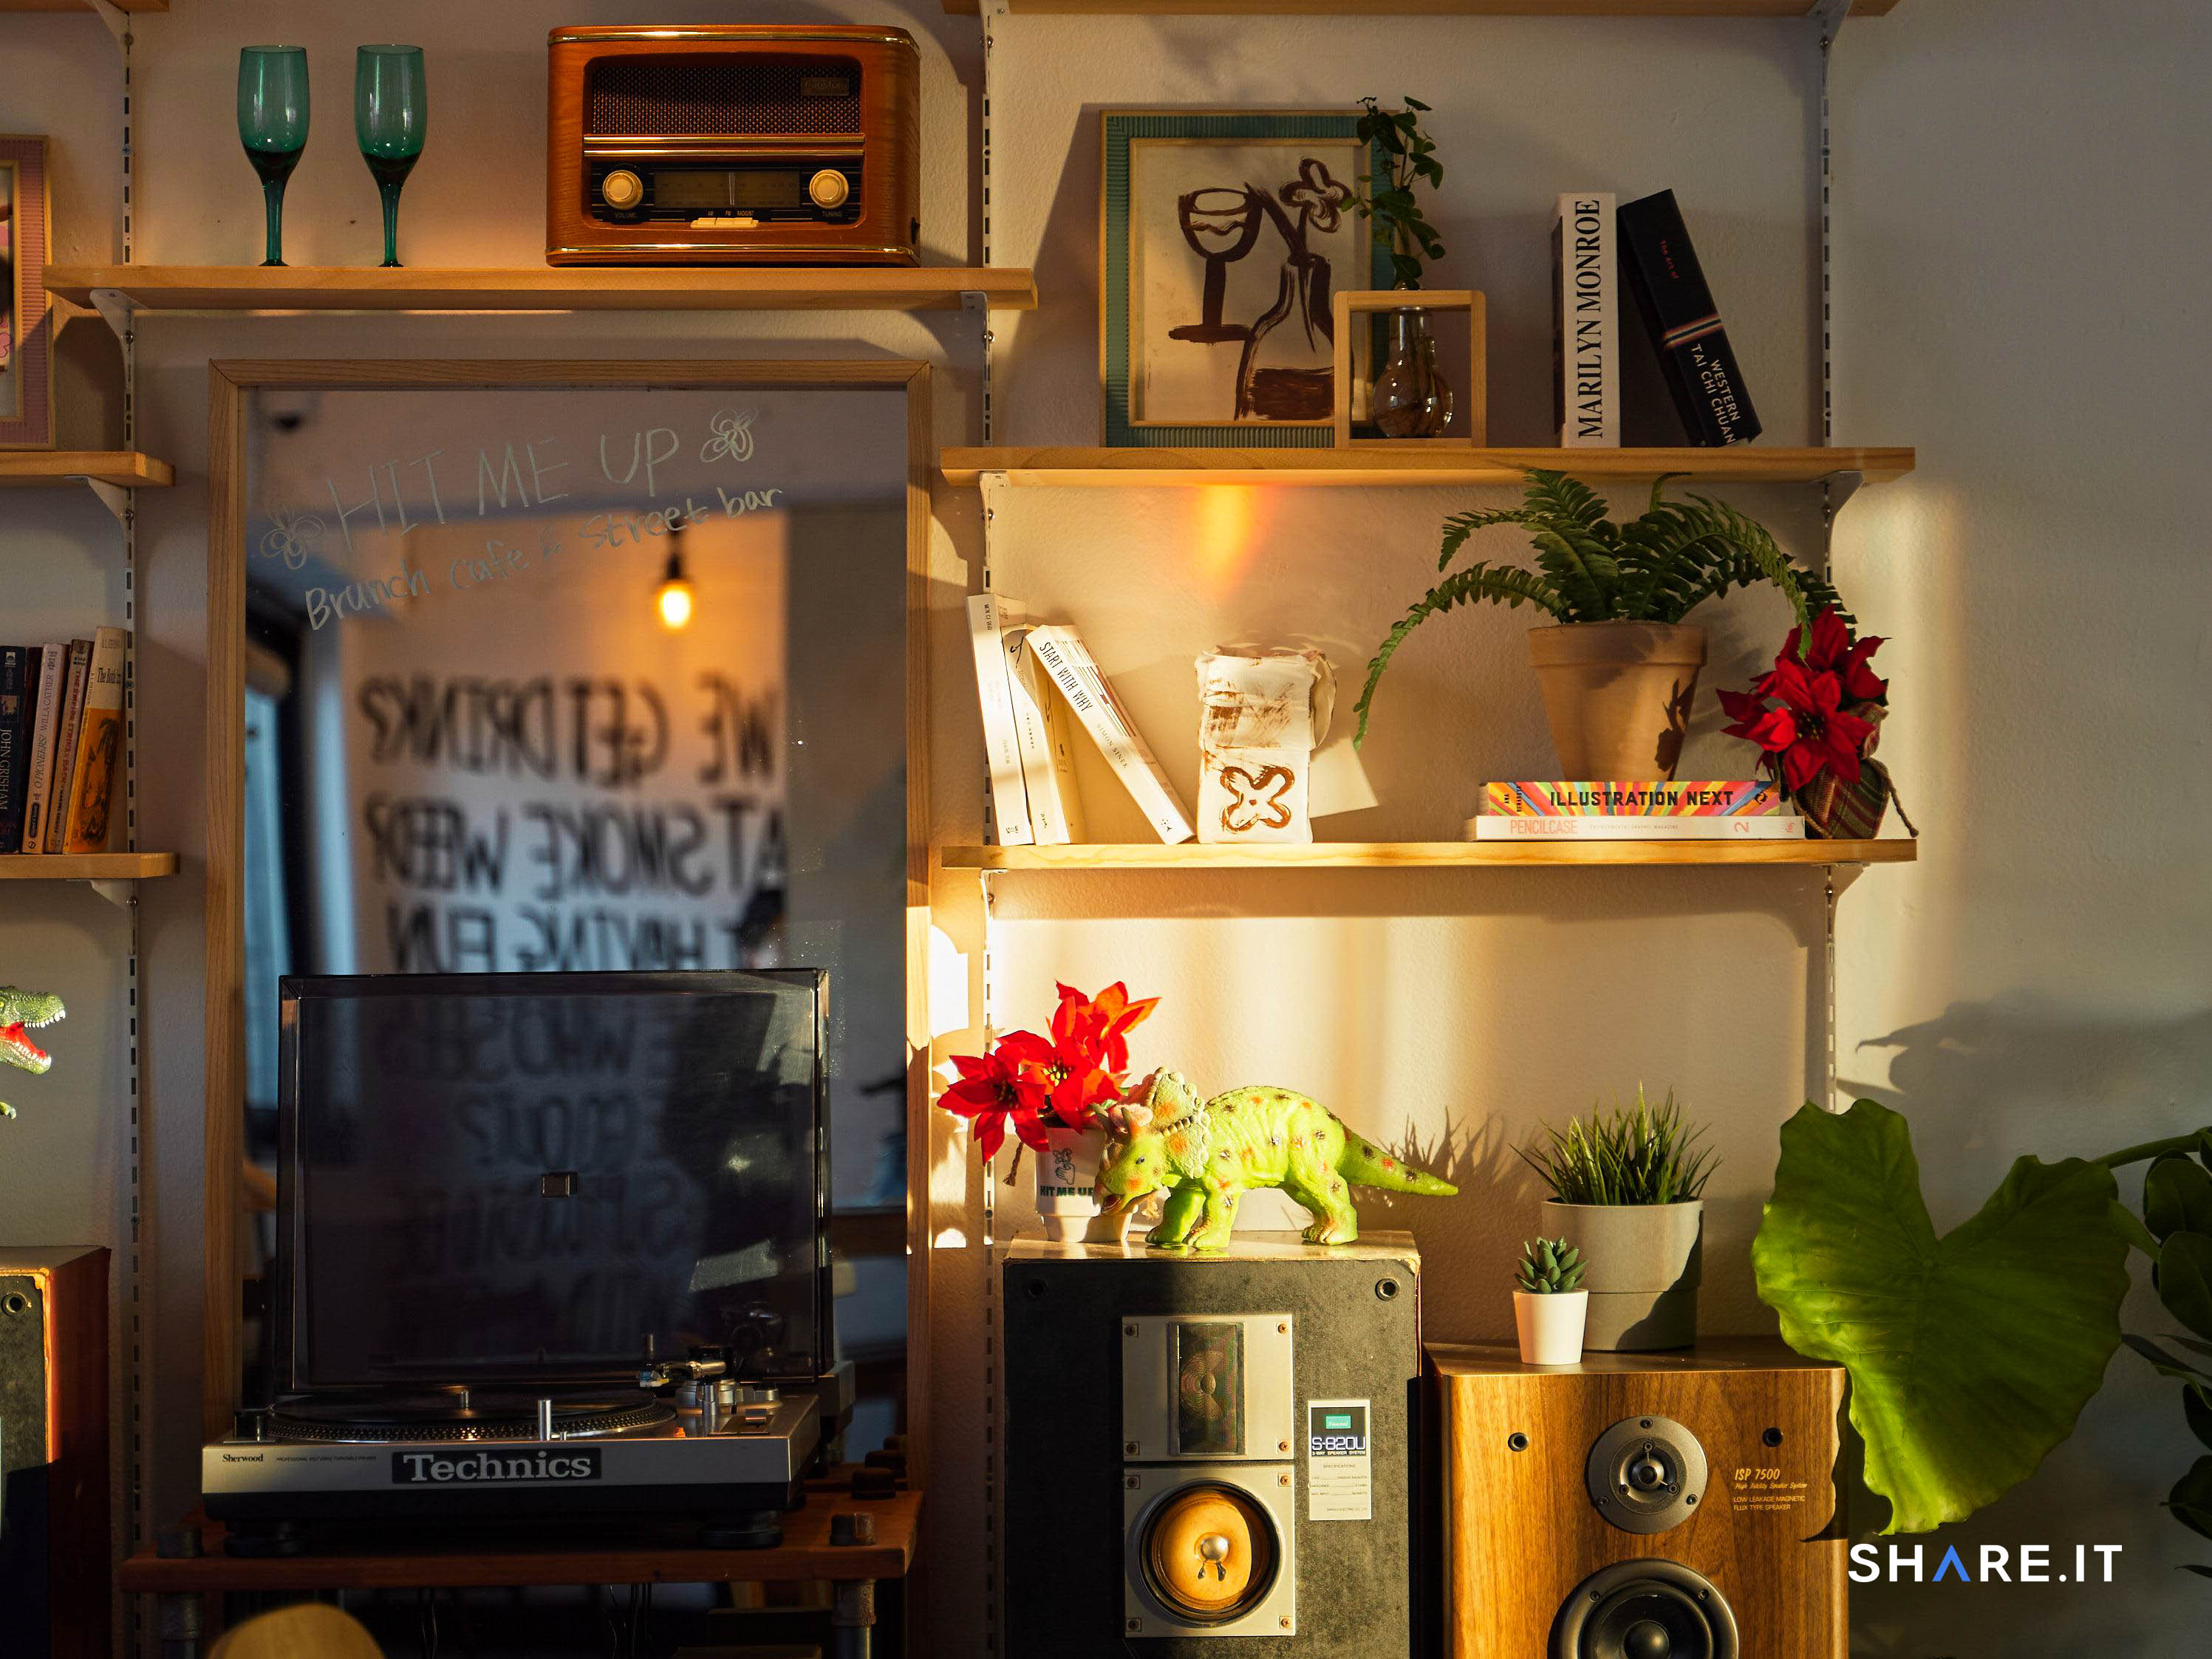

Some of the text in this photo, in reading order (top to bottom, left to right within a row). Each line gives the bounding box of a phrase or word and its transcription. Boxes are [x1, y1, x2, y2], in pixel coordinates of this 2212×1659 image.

[1575, 199, 1602, 439] MARILYN MONROE
[1691, 343, 1736, 444] TAI CHI CHUAN
[1710, 359, 1741, 421] WESTERN
[327, 427, 680, 550] HIT ME UP
[305, 559, 431, 631] Brunch
[717, 485, 784, 519] bar
[44, 674, 54, 706] CATHER
[1040, 642, 1093, 713] START WITH WHY
[41, 707, 50, 731] WILLA
[0, 728, 12, 757] JOHN
[35, 734, 50, 781] PIONEERS!
[1096, 722, 1130, 770] SIMON SINEK
[0, 759, 10, 810] GRISHAM
[1551, 790, 1733, 807] ILLUSTRATION NEXT
[1510, 819, 1577, 834] PENCILCASE
[1733, 821, 1749, 833] 2
[1040, 1186, 1055, 1197] HIT
[1056, 1187, 1076, 1197] ME
[222, 1454, 264, 1463] Sherwood
[1312, 1437, 1366, 1451] S-820U
[403, 1450, 592, 1481] Technics
[1734, 1468, 1781, 1480] ISP 7500
[1789, 1482, 1808, 1490] System
